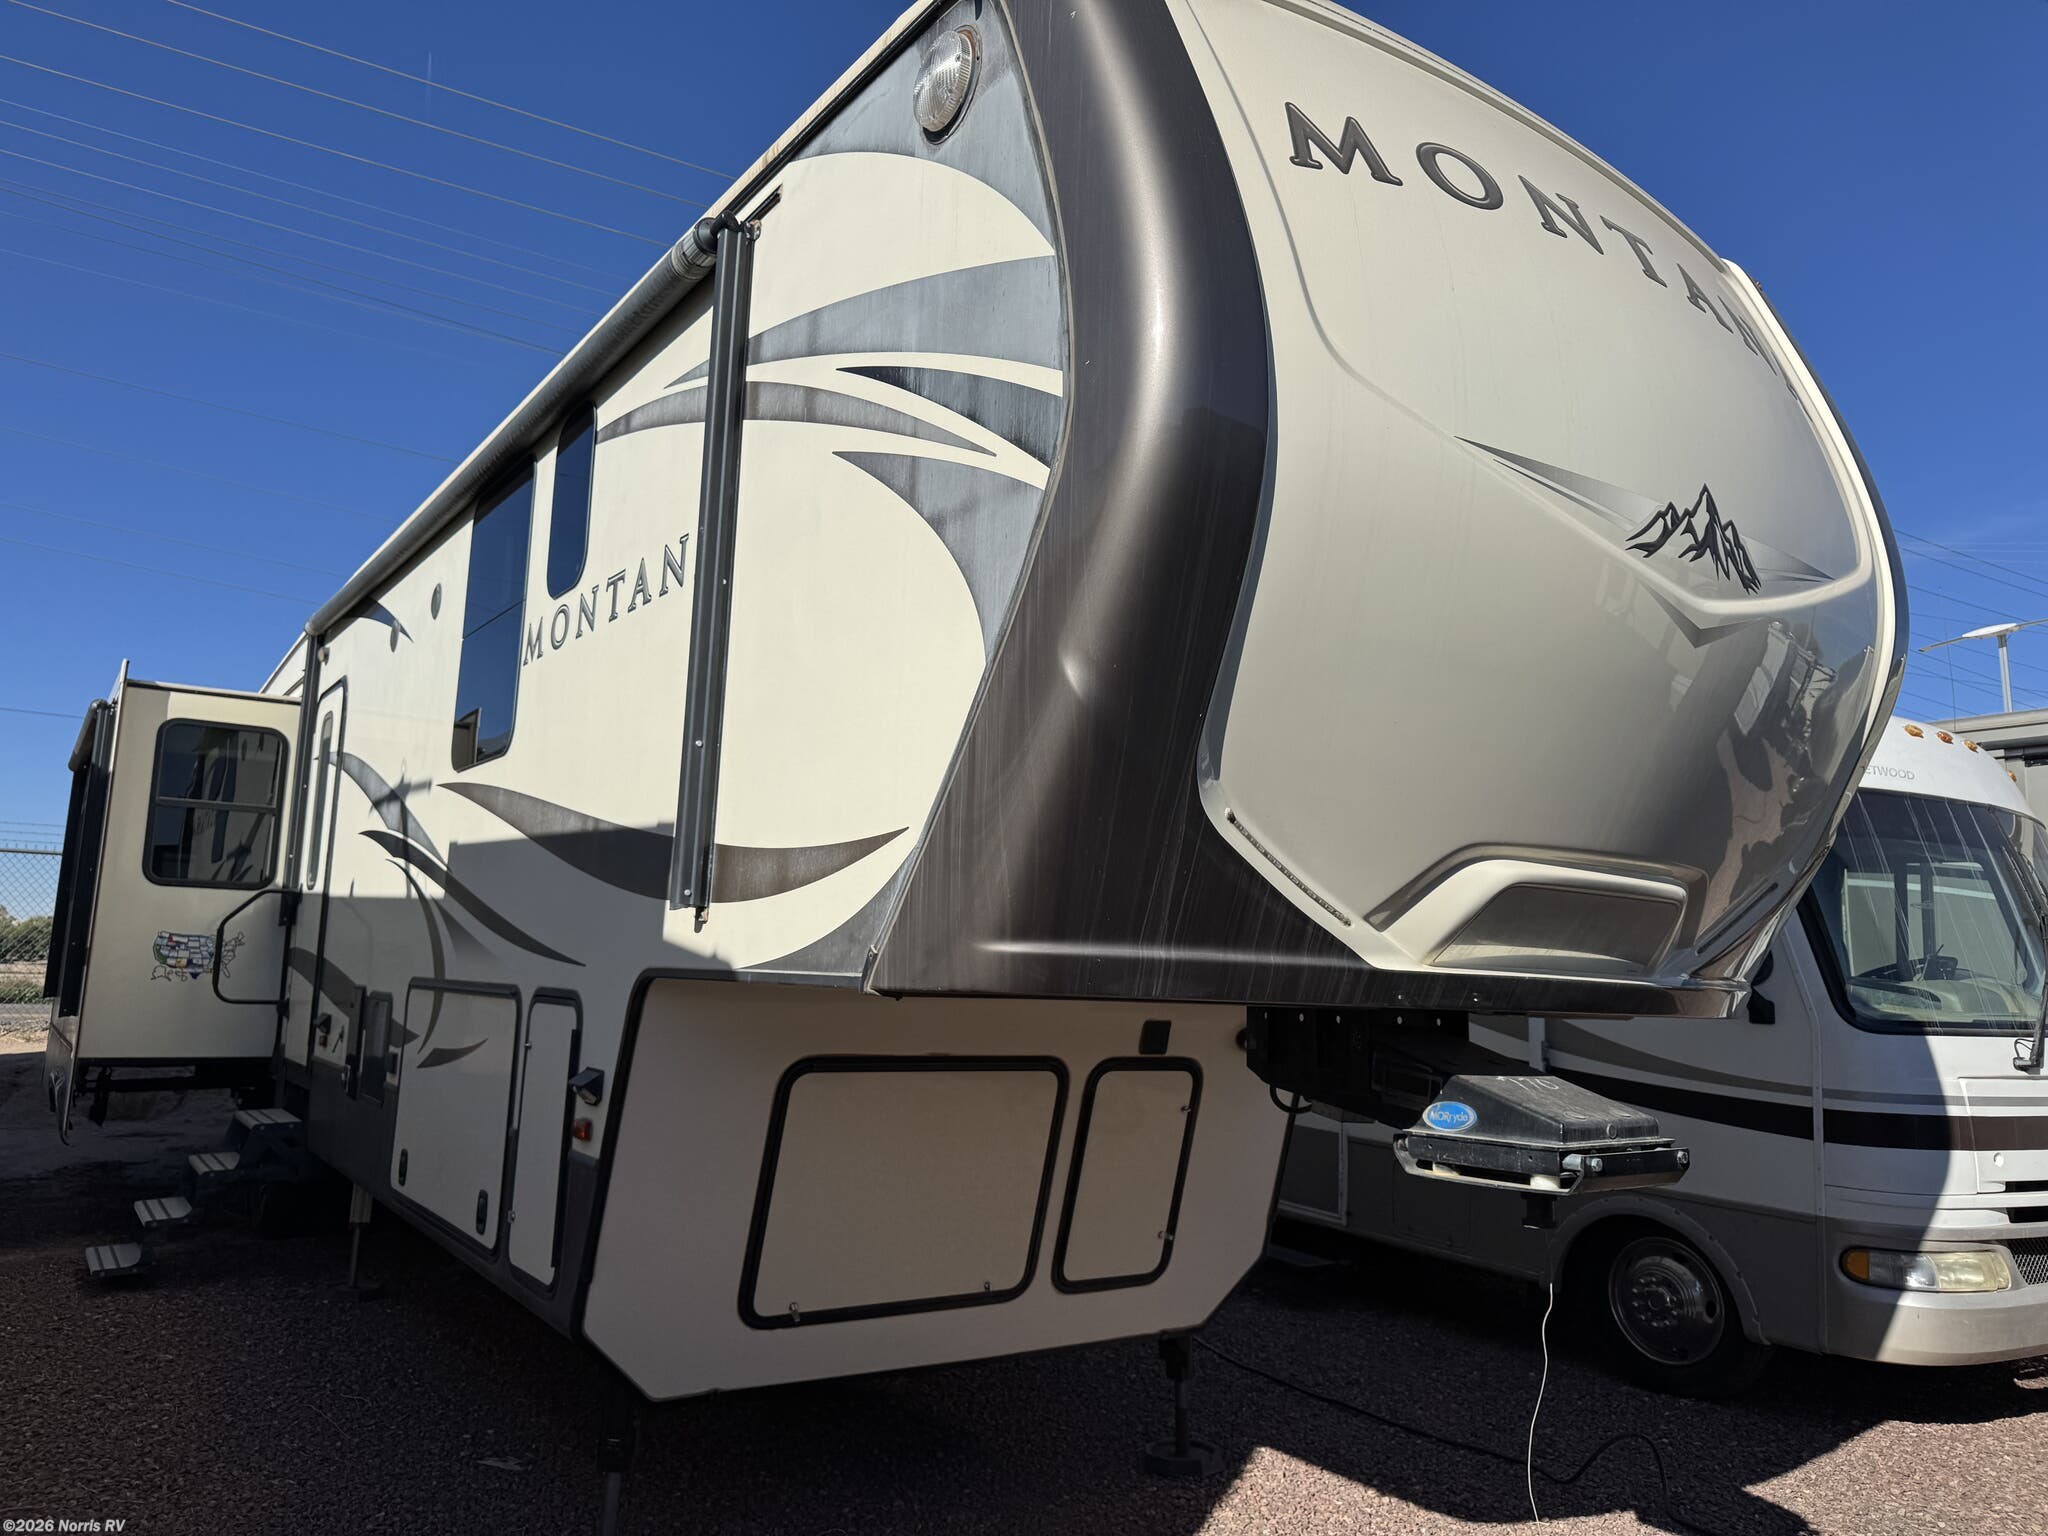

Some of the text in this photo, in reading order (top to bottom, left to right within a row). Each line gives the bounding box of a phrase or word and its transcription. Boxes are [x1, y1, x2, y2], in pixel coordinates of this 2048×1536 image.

[1284, 100, 1813, 423] MONTAN
[522, 532, 690, 667] MONTAN
[1865, 764, 1916, 780] ETWOOD
